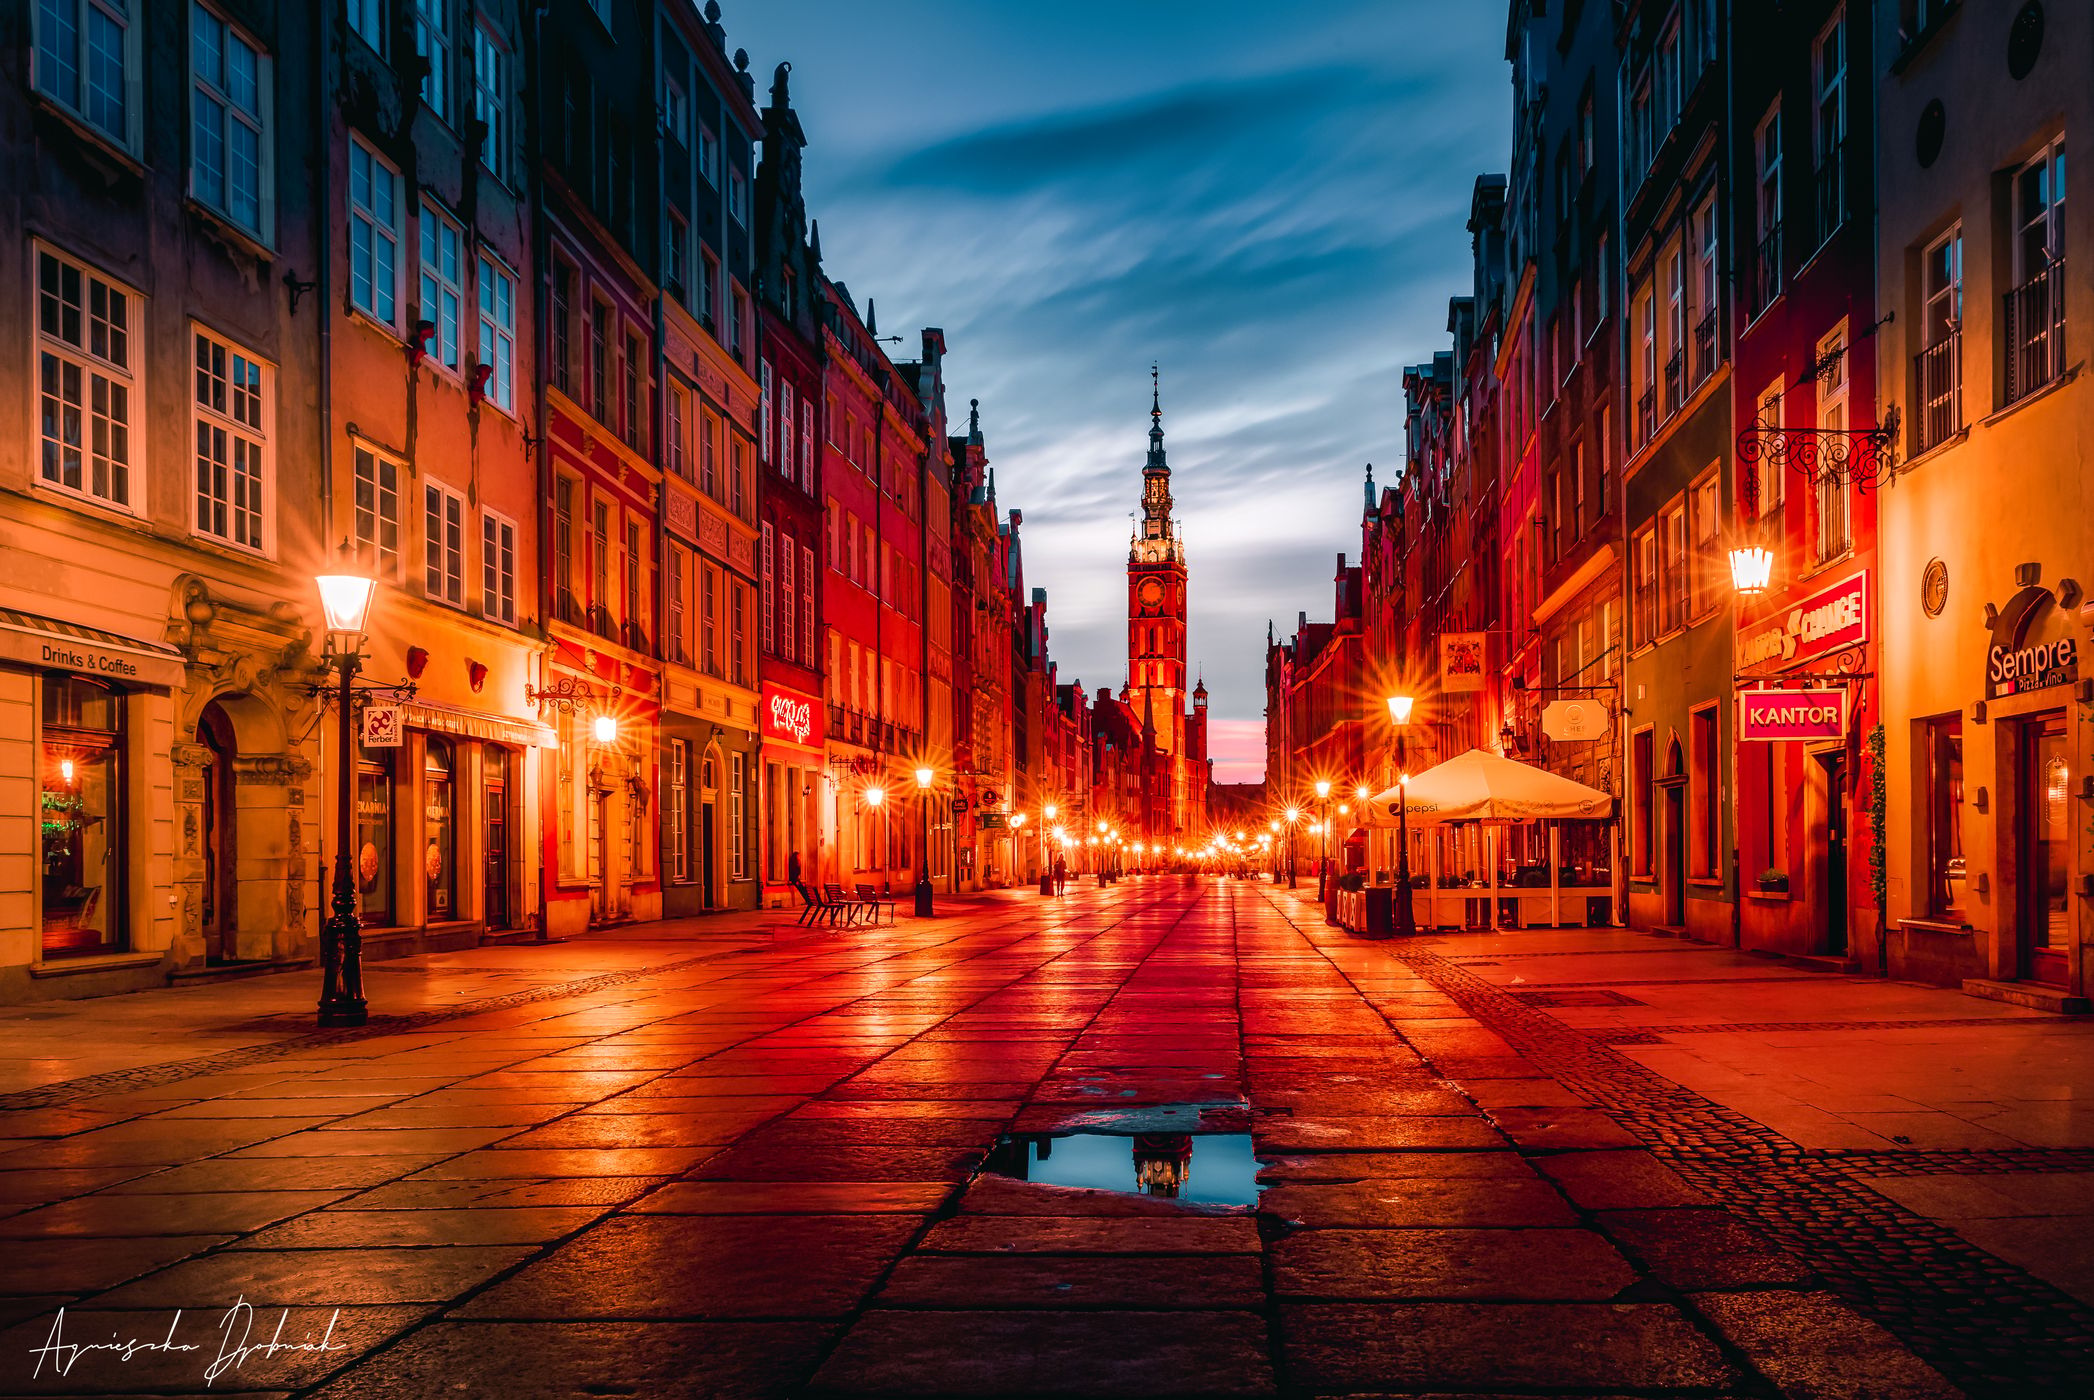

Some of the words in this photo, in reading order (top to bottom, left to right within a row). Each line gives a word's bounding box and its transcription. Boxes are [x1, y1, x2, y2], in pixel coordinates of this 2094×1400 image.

[42, 645, 83, 667] Drinks
[87, 654, 96, 669] &
[98, 656, 137, 676] Coffee
[1991, 638, 2071, 682] Sempre
[1750, 706, 1839, 726] KANTOR
[368, 735, 393, 744] Ferber
[1406, 803, 1438, 815] pepsi
